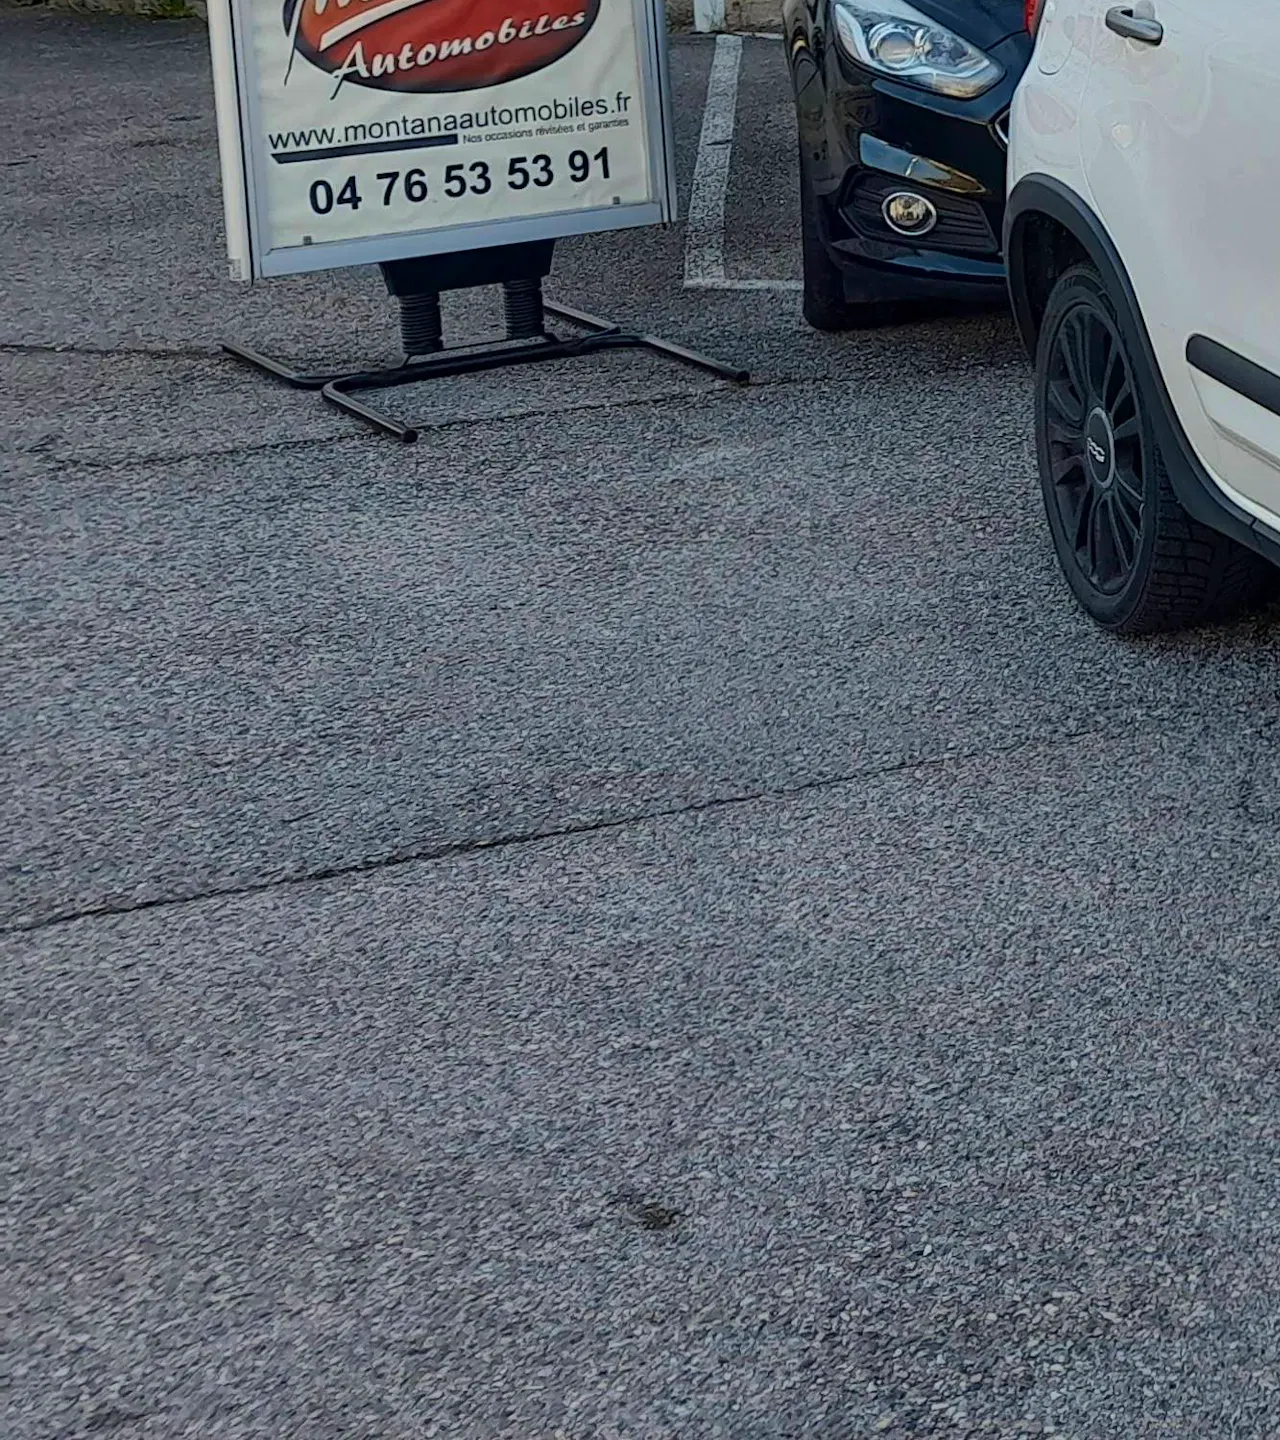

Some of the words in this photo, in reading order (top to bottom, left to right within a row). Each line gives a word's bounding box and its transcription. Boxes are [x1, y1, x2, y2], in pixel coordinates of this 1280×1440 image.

[331, 10, 587, 92] Automobiles
[268, 91, 631, 150] www.montanaautomobiles.fr
[463, 134, 482, 144] Nos
[485, 128, 533, 142] occasions
[577, 122, 586, 131] et
[309, 175, 363, 215] 04
[376, 168, 428, 206] 76
[443, 161, 492, 198] 53
[507, 154, 554, 191] 53
[568, 147, 611, 183] 91
